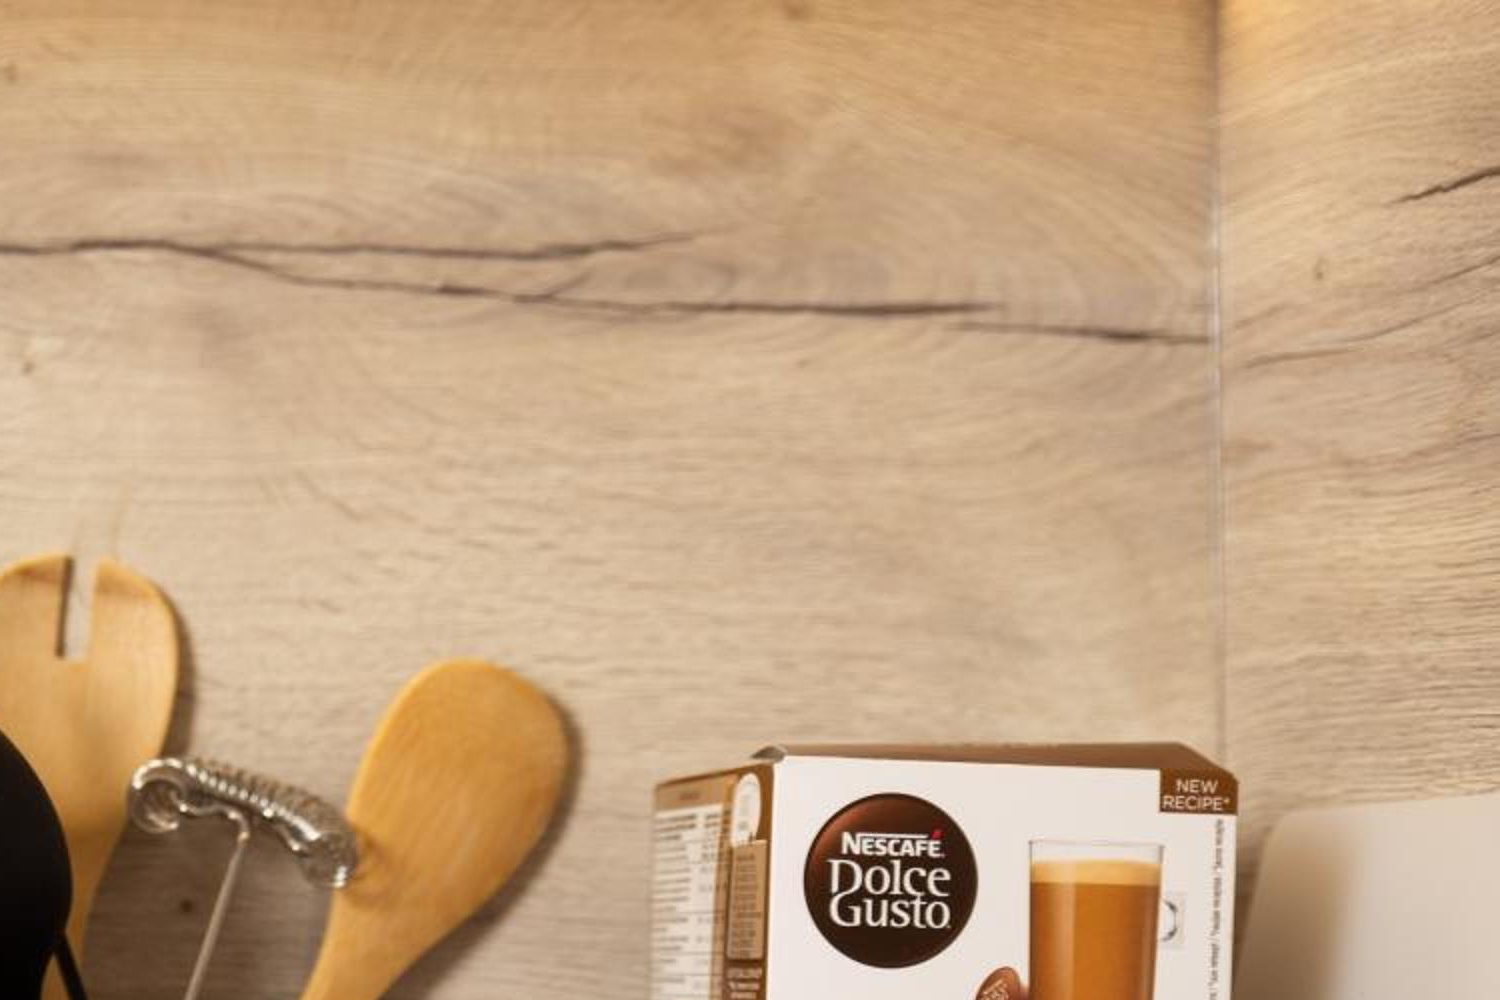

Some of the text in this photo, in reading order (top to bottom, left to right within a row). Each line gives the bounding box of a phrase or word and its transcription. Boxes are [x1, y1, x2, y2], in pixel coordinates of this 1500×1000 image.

[1175, 778, 1219, 793] NEW
[841, 829, 943, 857] NESCAFÉ
[827, 858, 951, 897] Dolce
[828, 893, 951, 928] Gusto
